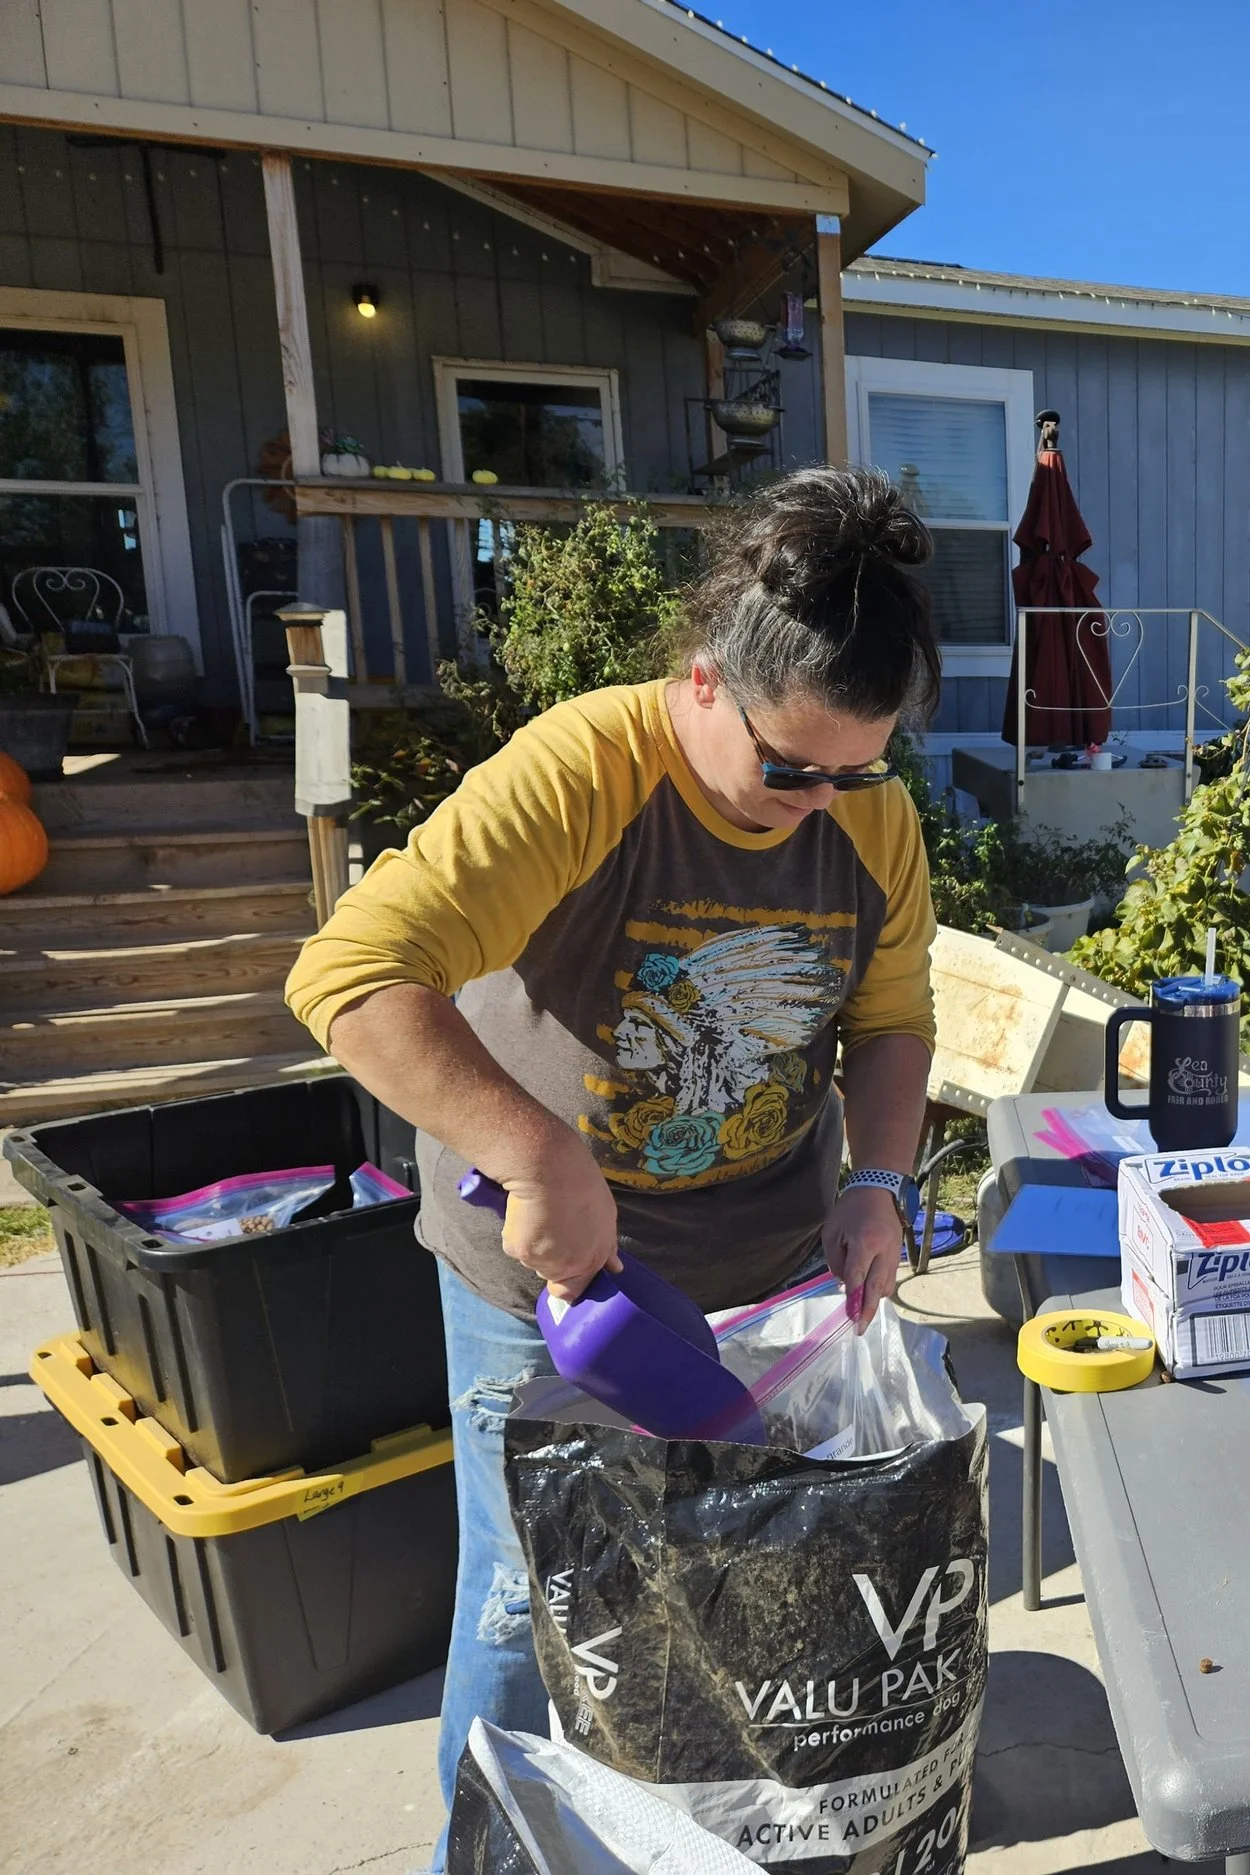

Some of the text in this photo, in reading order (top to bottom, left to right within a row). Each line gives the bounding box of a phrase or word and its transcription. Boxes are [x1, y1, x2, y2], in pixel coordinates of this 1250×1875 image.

[1172, 1056, 1208, 1079] Lea
[1167, 1095, 1185, 1104] FAIR
[1186, 1097, 1204, 1106] AND
[303, 1487, 335, 1502] Large
[852, 1558, 974, 1662] VP
[571, 1625, 623, 1700] VP
[735, 1648, 962, 1721] VALU PAK
[794, 1690, 961, 1751] performance dog
[736, 1774, 944, 1848] ACTIVE ADULTS &
[819, 1758, 939, 1814] FORMULATED
